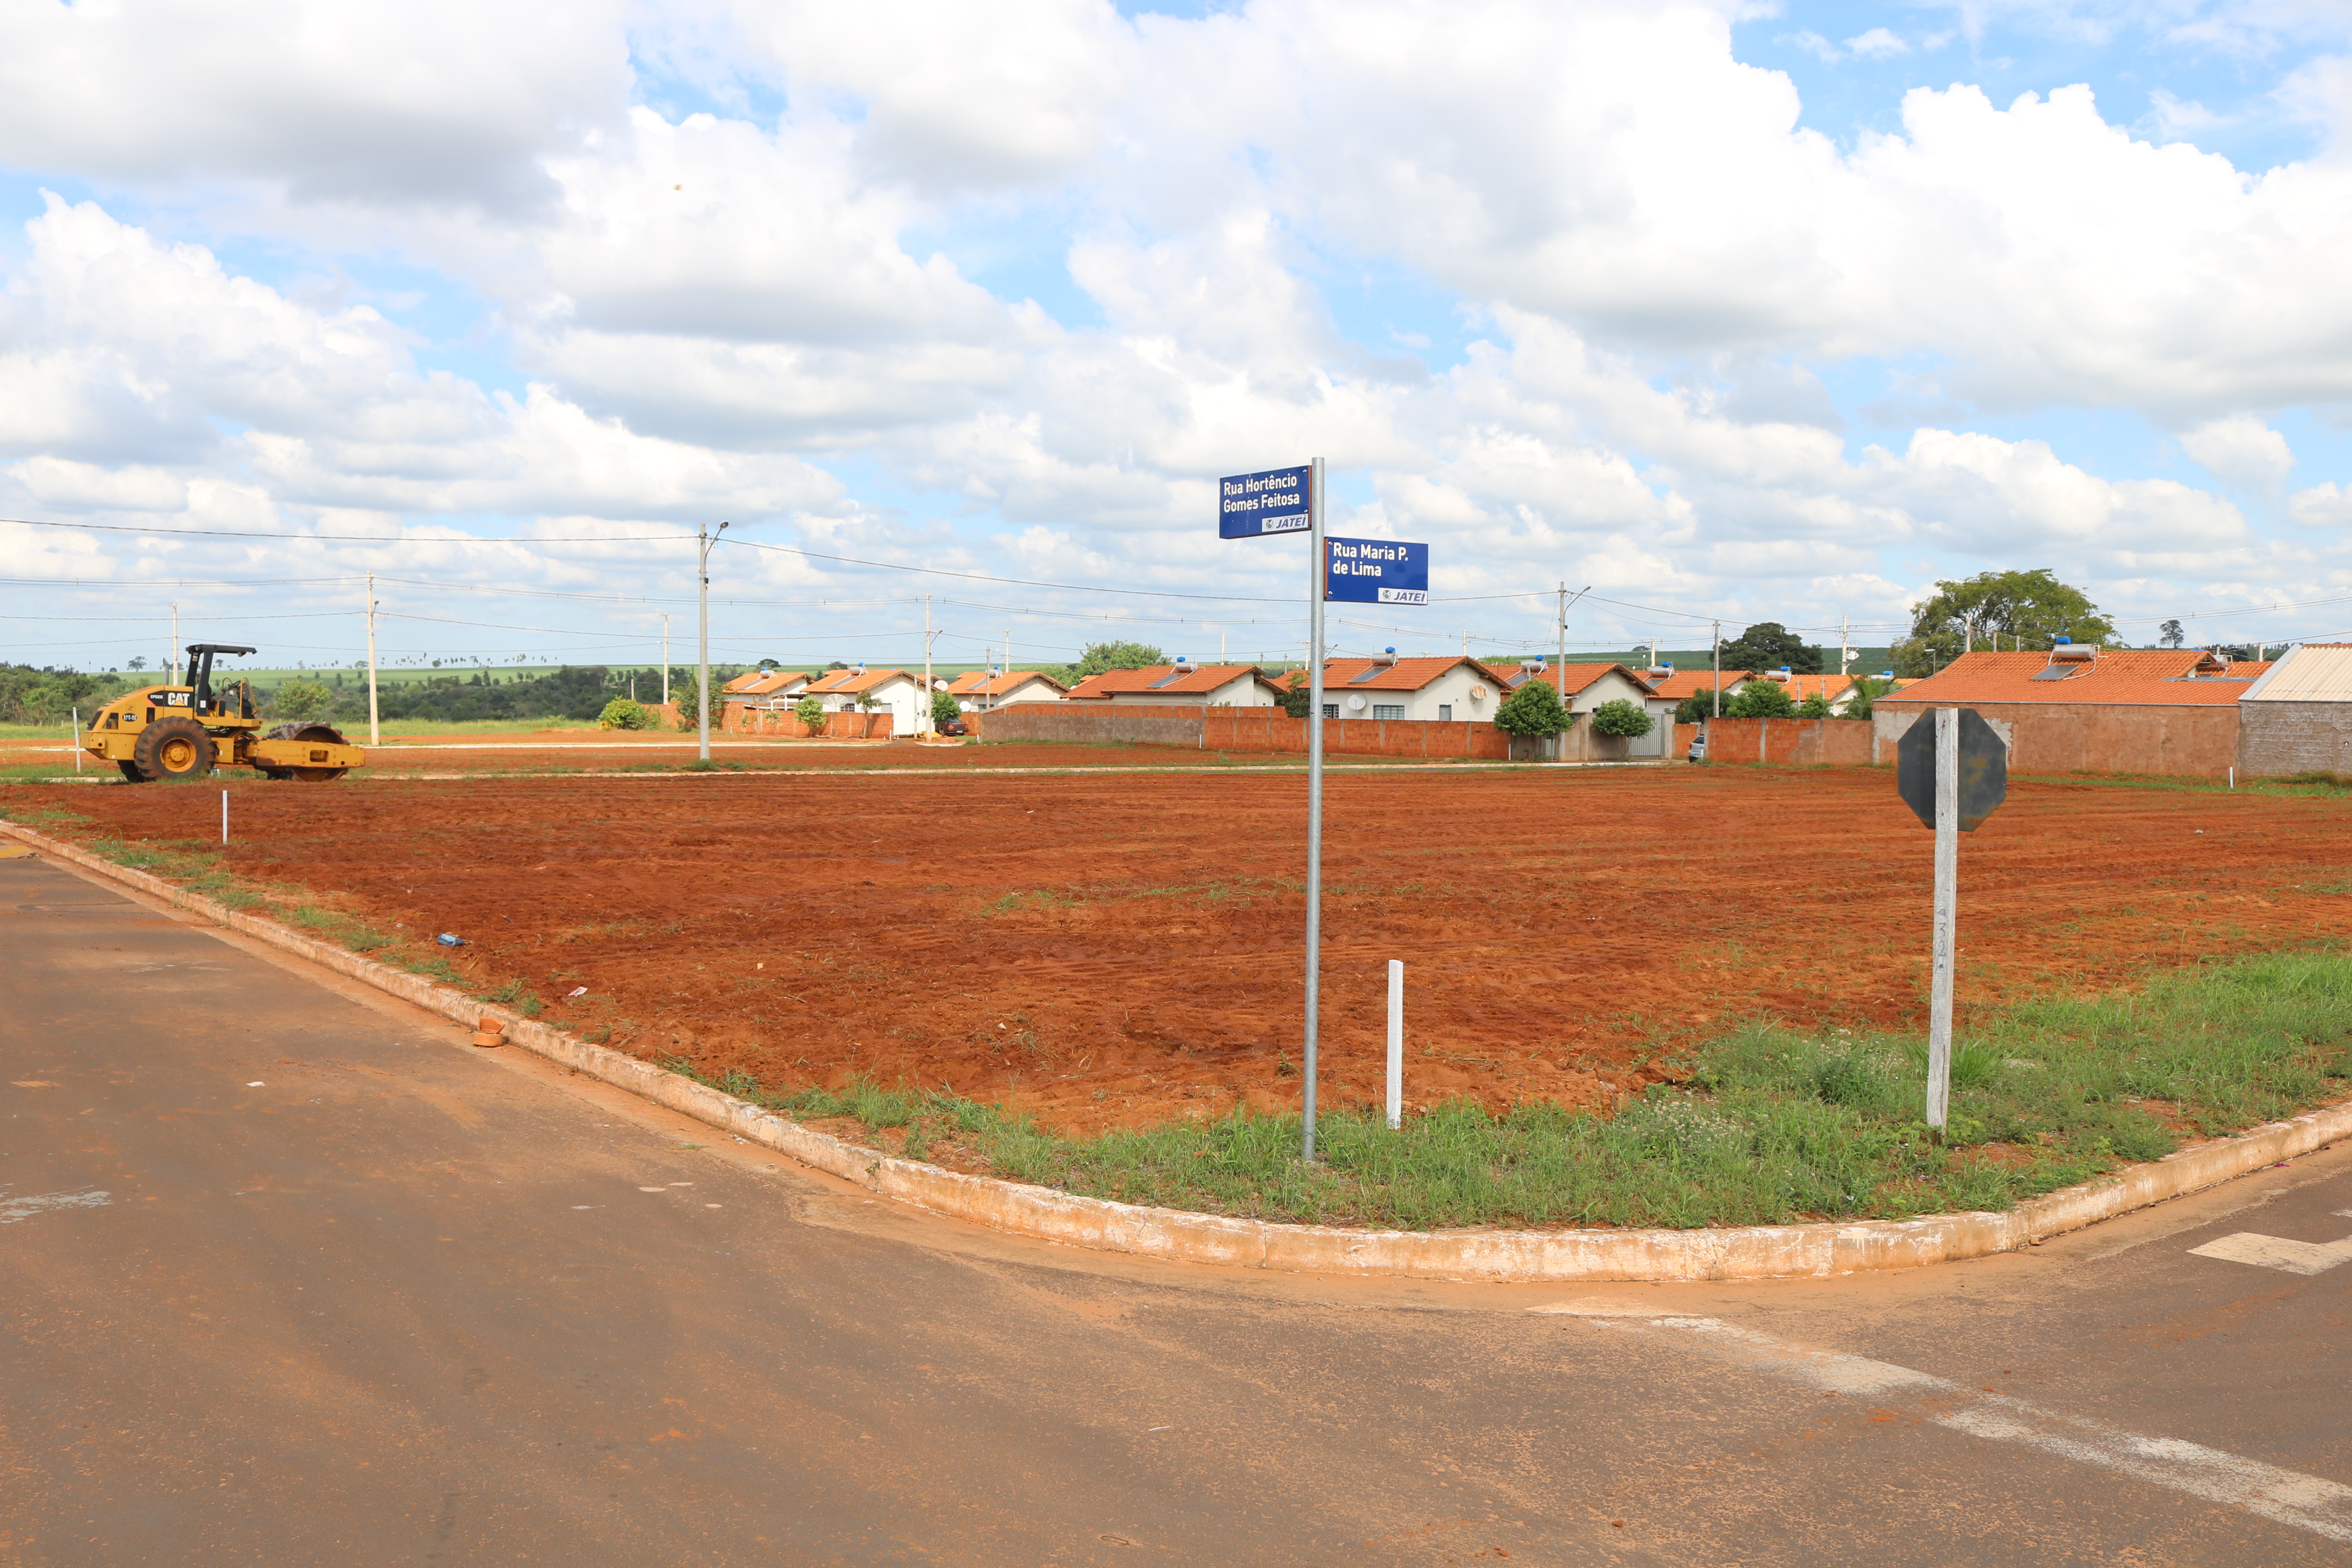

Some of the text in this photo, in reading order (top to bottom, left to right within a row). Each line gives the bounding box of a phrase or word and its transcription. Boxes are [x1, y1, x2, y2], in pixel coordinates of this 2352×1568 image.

[1224, 473, 1298, 496] Rua Hortêncio
[1223, 492, 1300, 513] Gomes Feitosa
[1276, 514, 1307, 529] JATEÍ
[1333, 541, 1409, 561] Rua Maria P.
[1332, 560, 1382, 577] de Lima
[1394, 591, 1426, 602] JATEÍ
[168, 692, 190, 707] CAT
